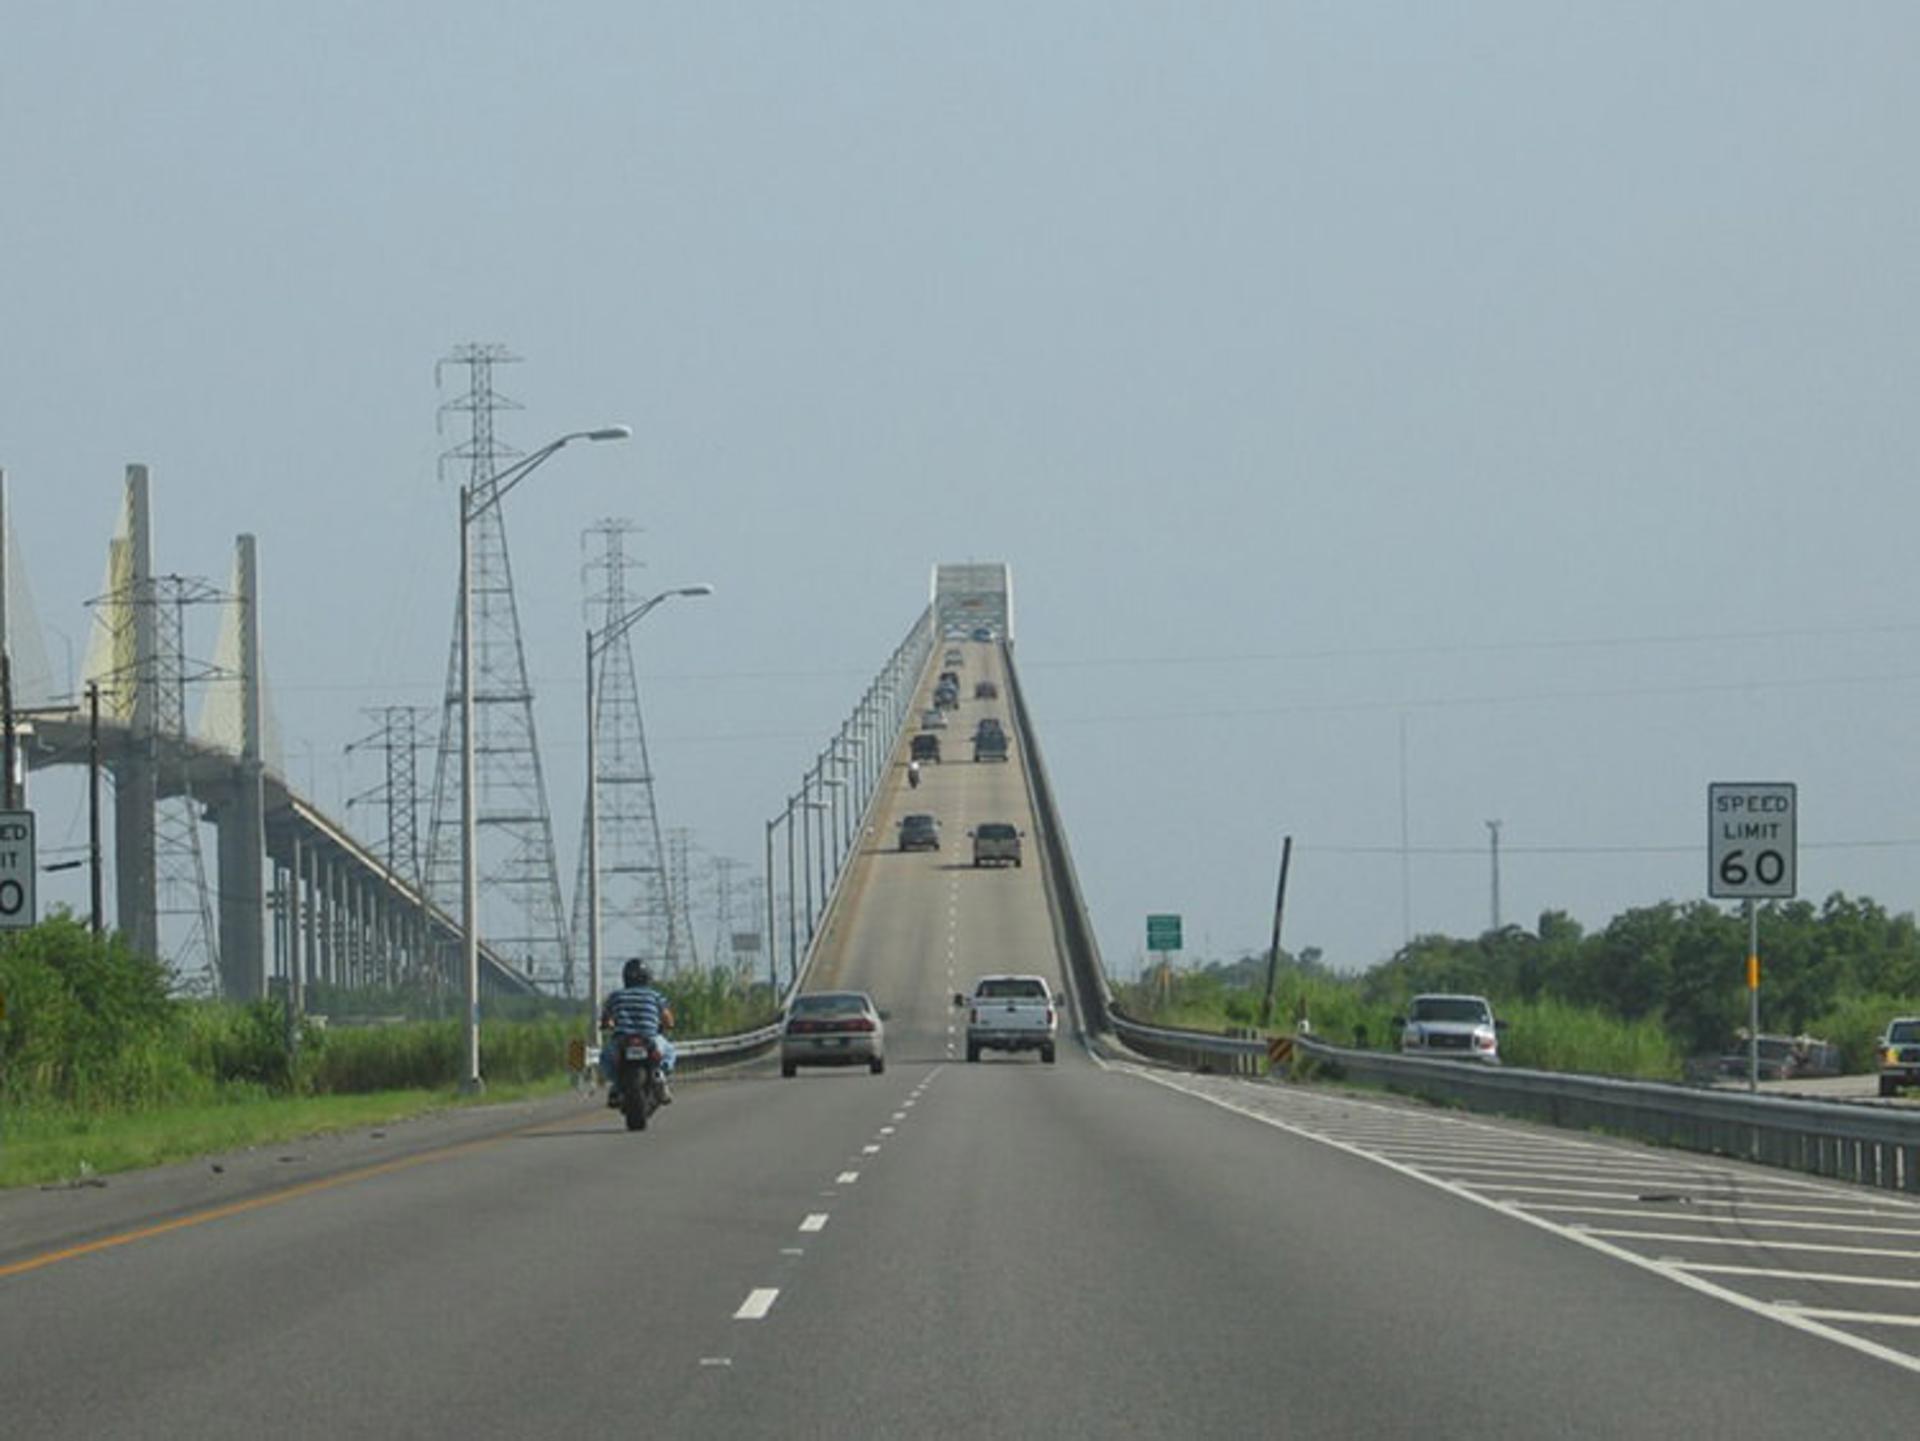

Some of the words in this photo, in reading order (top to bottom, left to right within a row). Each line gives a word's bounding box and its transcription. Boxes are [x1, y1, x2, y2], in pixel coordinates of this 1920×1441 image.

[1717, 795, 1788, 812] SPEED
[1724, 822, 1781, 840] LIMIT
[1721, 849, 1785, 886] 60
